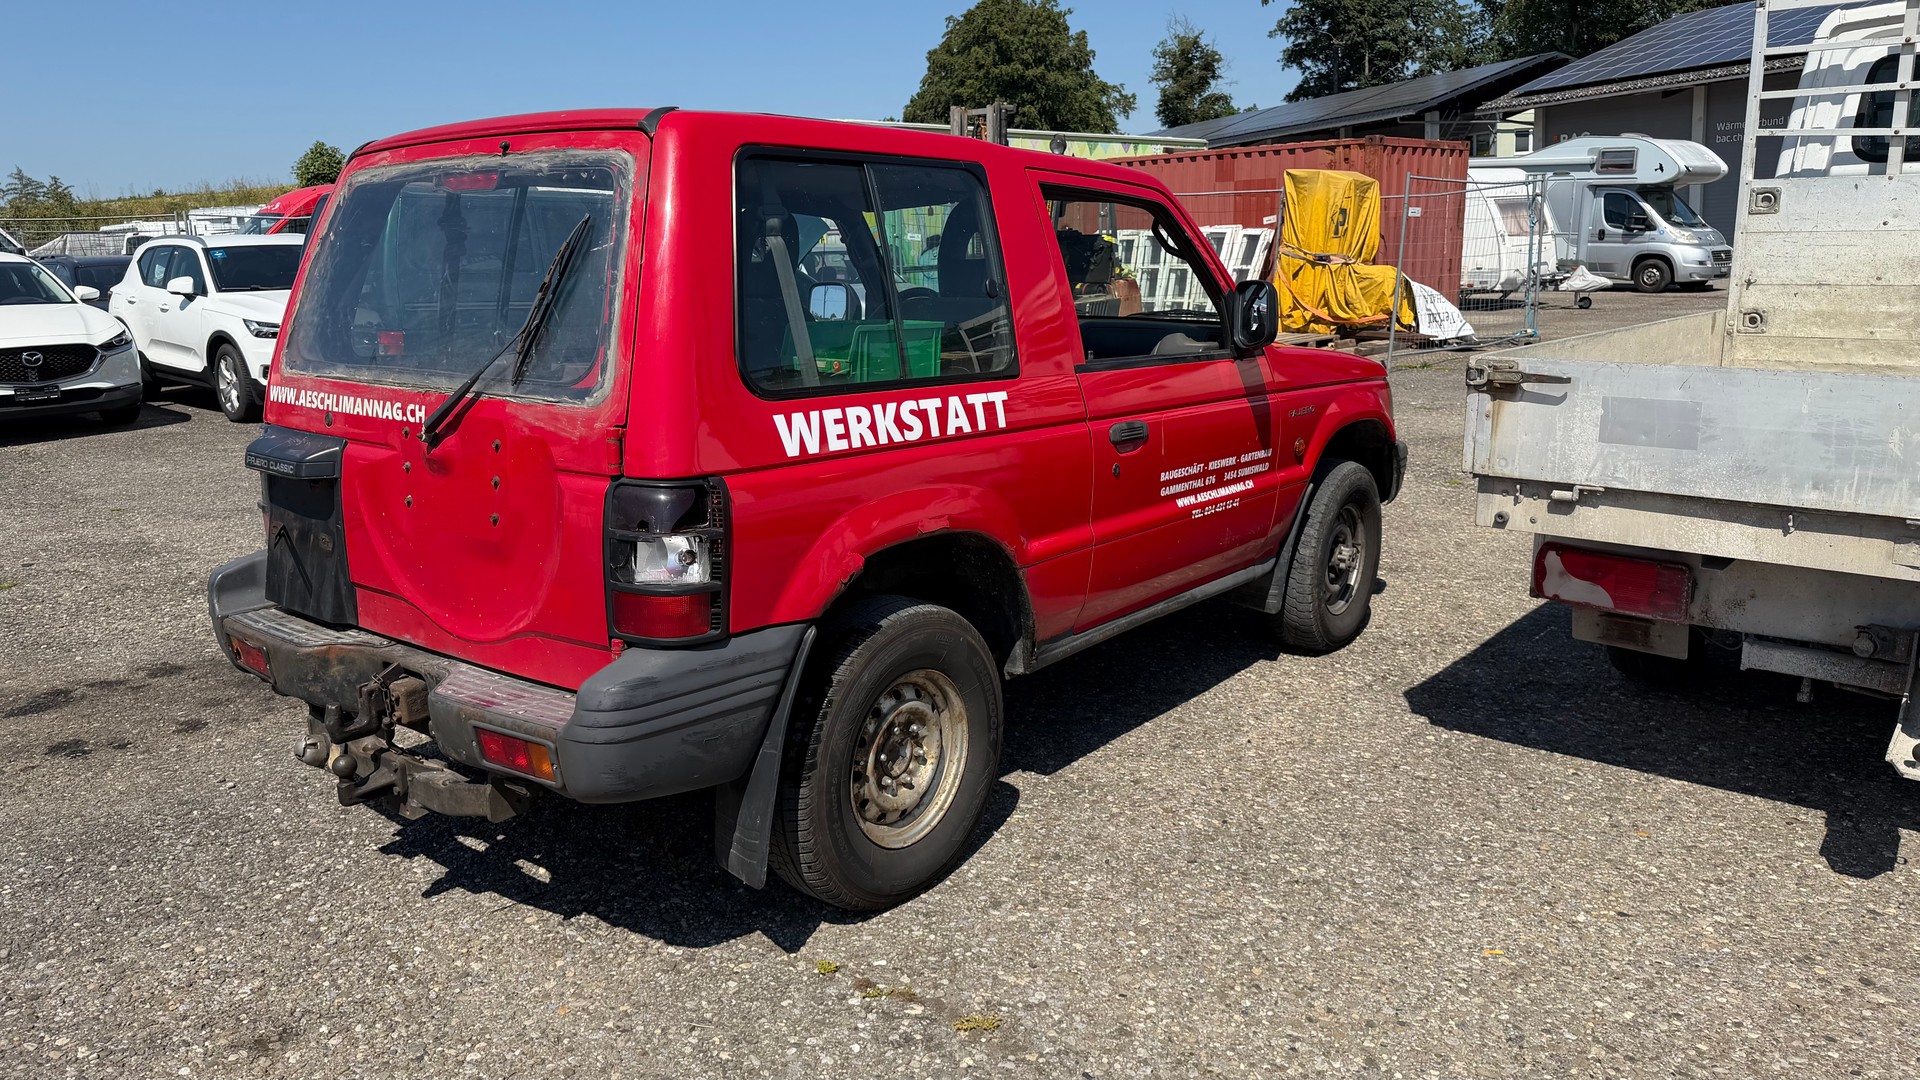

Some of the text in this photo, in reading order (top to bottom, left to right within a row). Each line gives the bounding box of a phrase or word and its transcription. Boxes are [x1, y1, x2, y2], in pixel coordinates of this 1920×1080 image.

[1715, 133, 1743, 143] bac.ch
[269, 384, 427, 424] WWW.AESCHLIMANNAG.CH
[772, 390, 1009, 458] WERKSTATT
[269, 461, 294, 474] CLASSIC
[1160, 463, 1205, 482] BAUGESCHÄFT
[1208, 456, 1237, 471] KIESWERK
[1240, 448, 1273, 463] GARTENBAU
[1160, 462, 1270, 497] GAMMENTHAL 676 3454 SUMISWALD
[1175, 479, 1255, 508] WWW.AESCHLIMANNAG.CH
